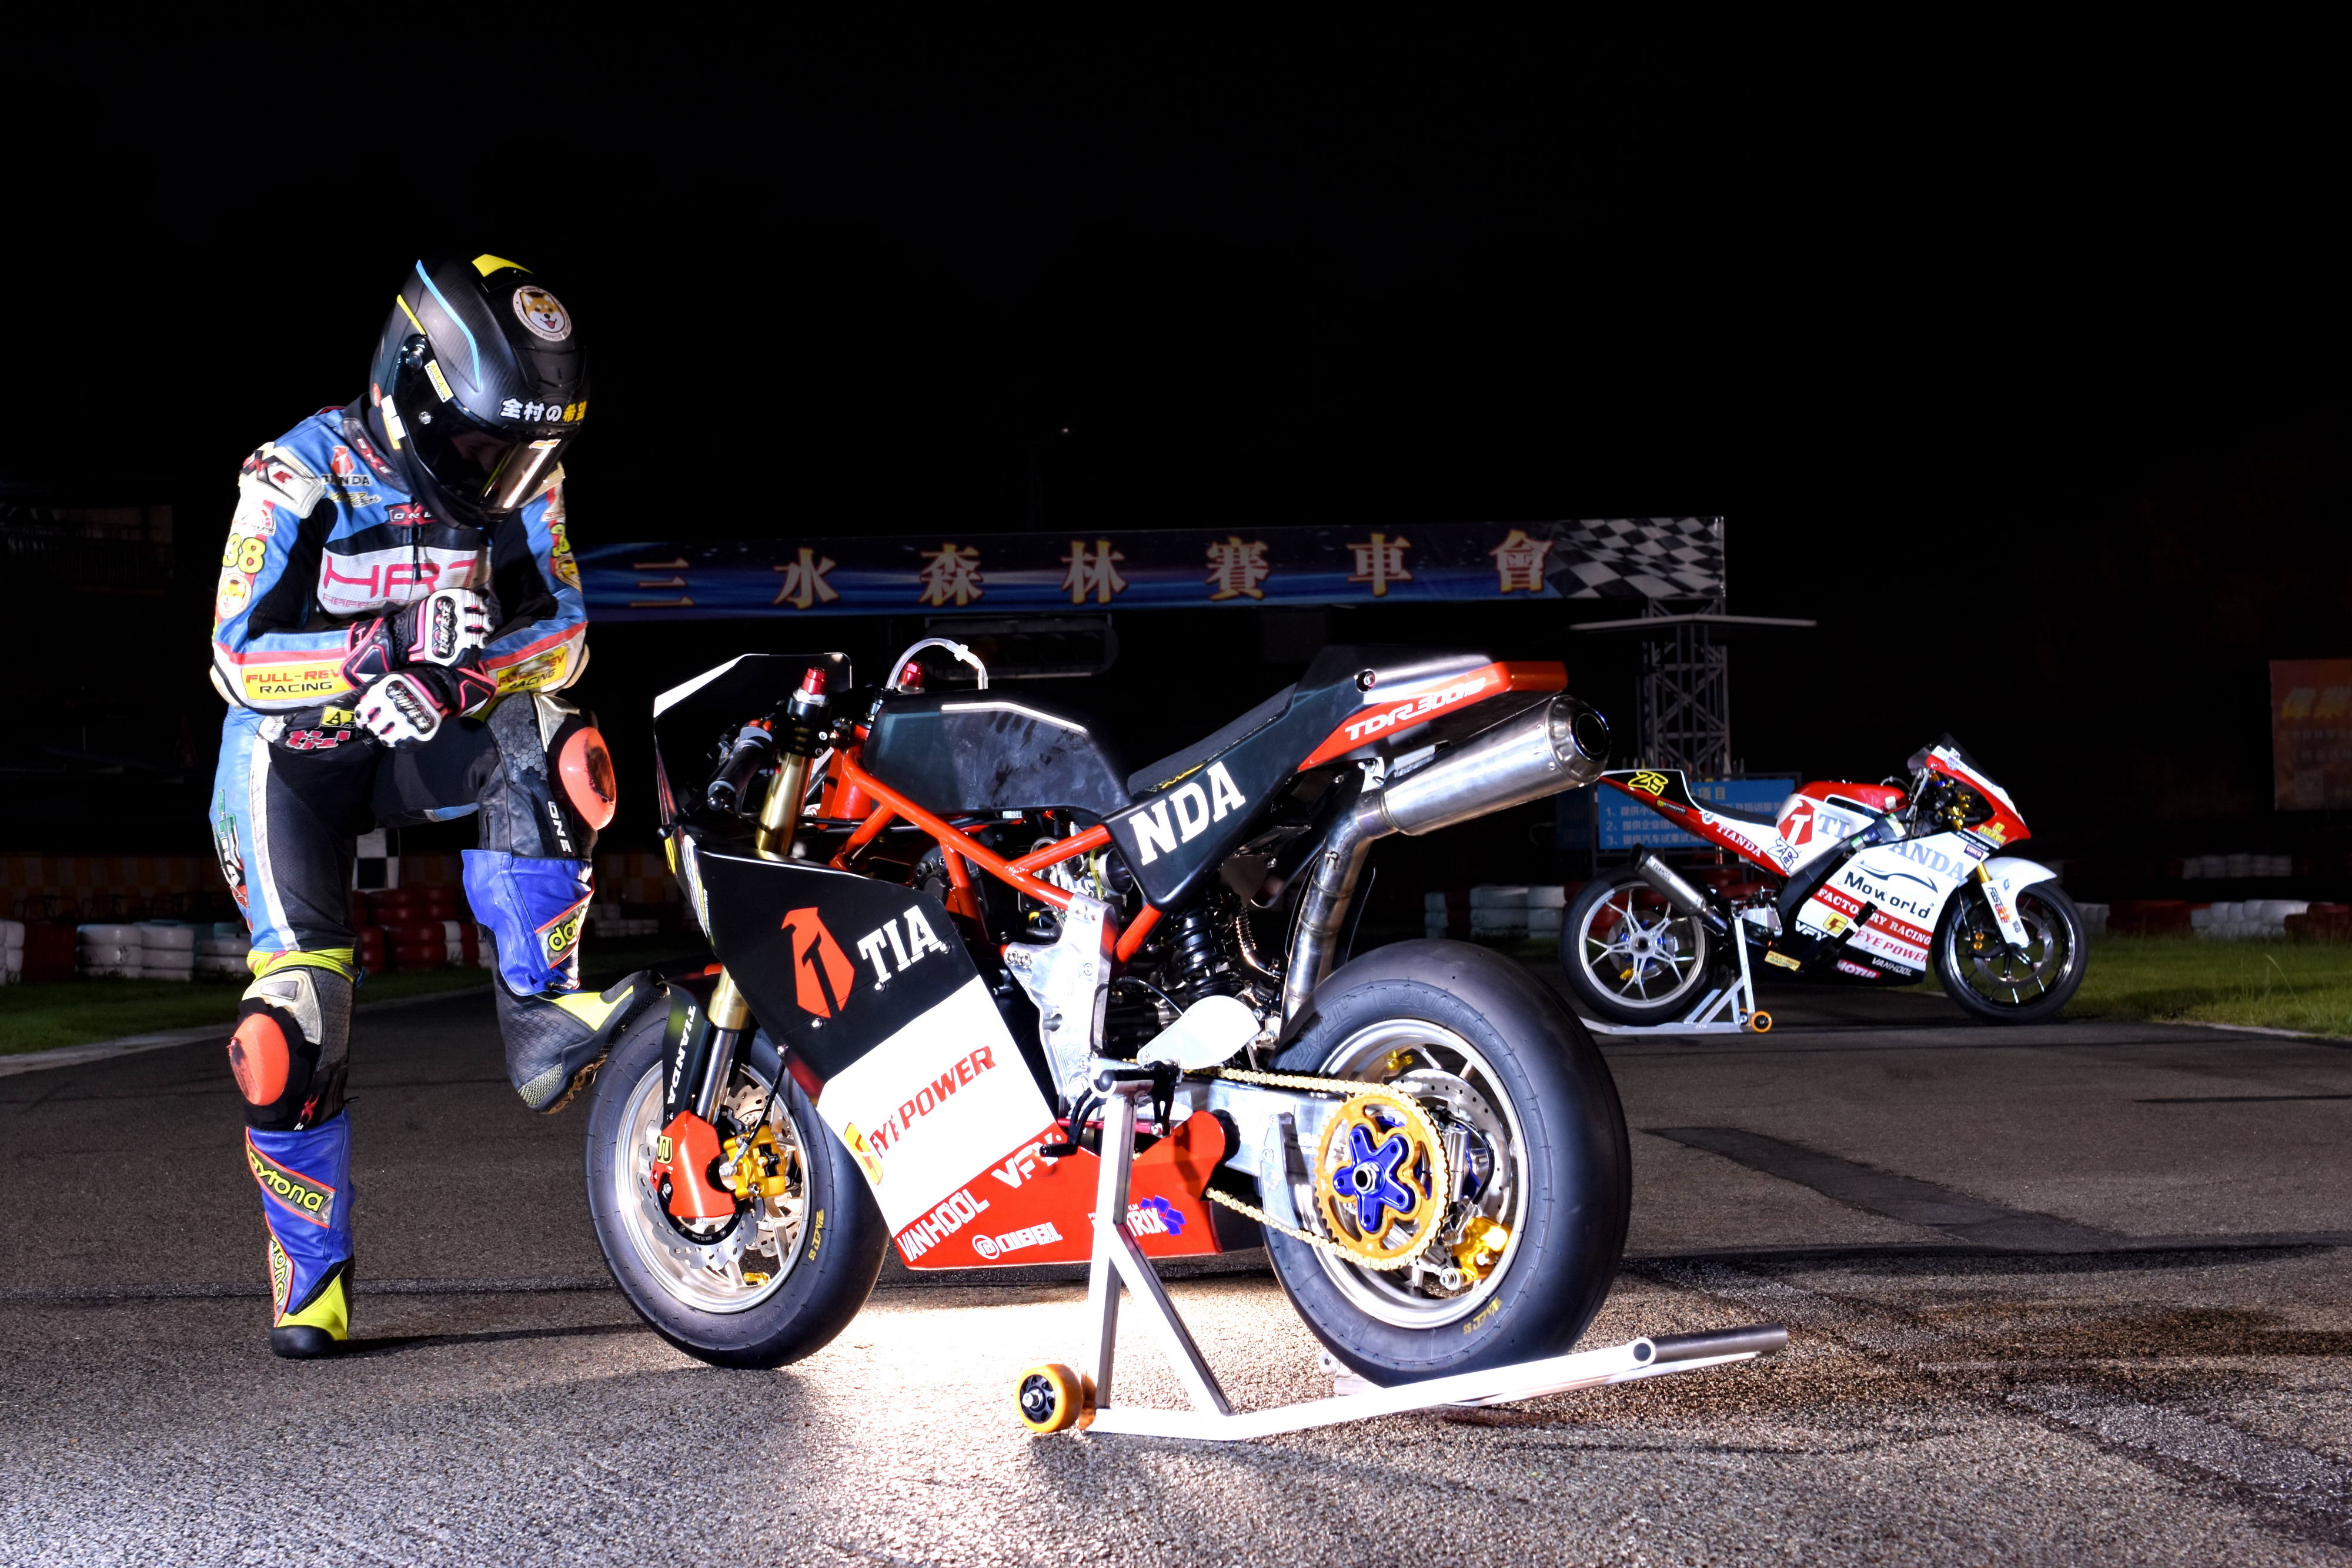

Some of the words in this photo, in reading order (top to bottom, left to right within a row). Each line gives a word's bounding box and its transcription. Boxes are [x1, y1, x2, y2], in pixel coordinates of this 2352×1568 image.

[222, 533, 267, 574] 38
[630, 529, 1553, 610] 三水森林賽車會
[246, 668, 340, 683] FULL-REV
[259, 681, 333, 694] RACING
[1628, 770, 1669, 796] 26
[1128, 761, 1247, 867] NDA
[1715, 821, 1763, 858] TIANDA
[1888, 841, 1969, 887] ANDA
[856, 904, 941, 983] TIA
[1795, 920, 1829, 941] VFY
[1855, 930, 1883, 948] FYE
[1889, 922, 1932, 945] RACING
[1872, 957, 1912, 977] VANHOOL
[667, 1005, 697, 1104] TIANDA
[897, 1045, 997, 1131] POWER
[247, 1143, 325, 1213] aytona
[896, 1188, 990, 1262] VANHOOL
